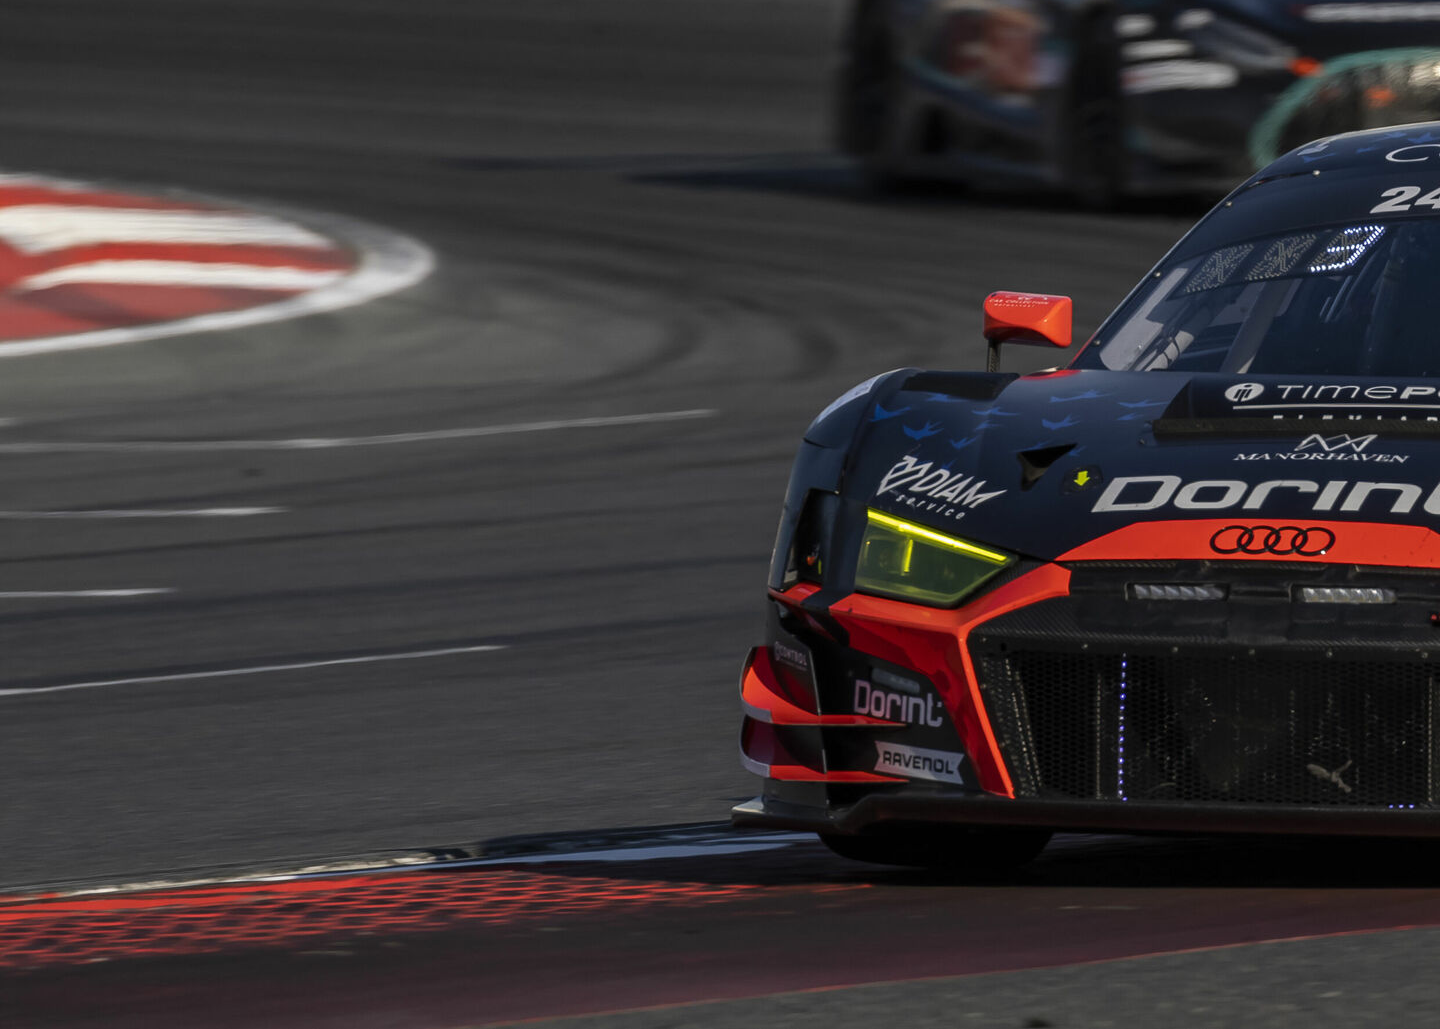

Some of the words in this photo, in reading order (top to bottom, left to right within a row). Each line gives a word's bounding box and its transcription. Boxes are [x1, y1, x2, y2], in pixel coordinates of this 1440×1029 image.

[1232, 451, 1410, 463] MANORHAVEN
[908, 468, 1008, 509] DIAM
[896, 494, 966, 520] service
[853, 679, 944, 728] Dorint
[882, 750, 955, 774] RAVENOL
